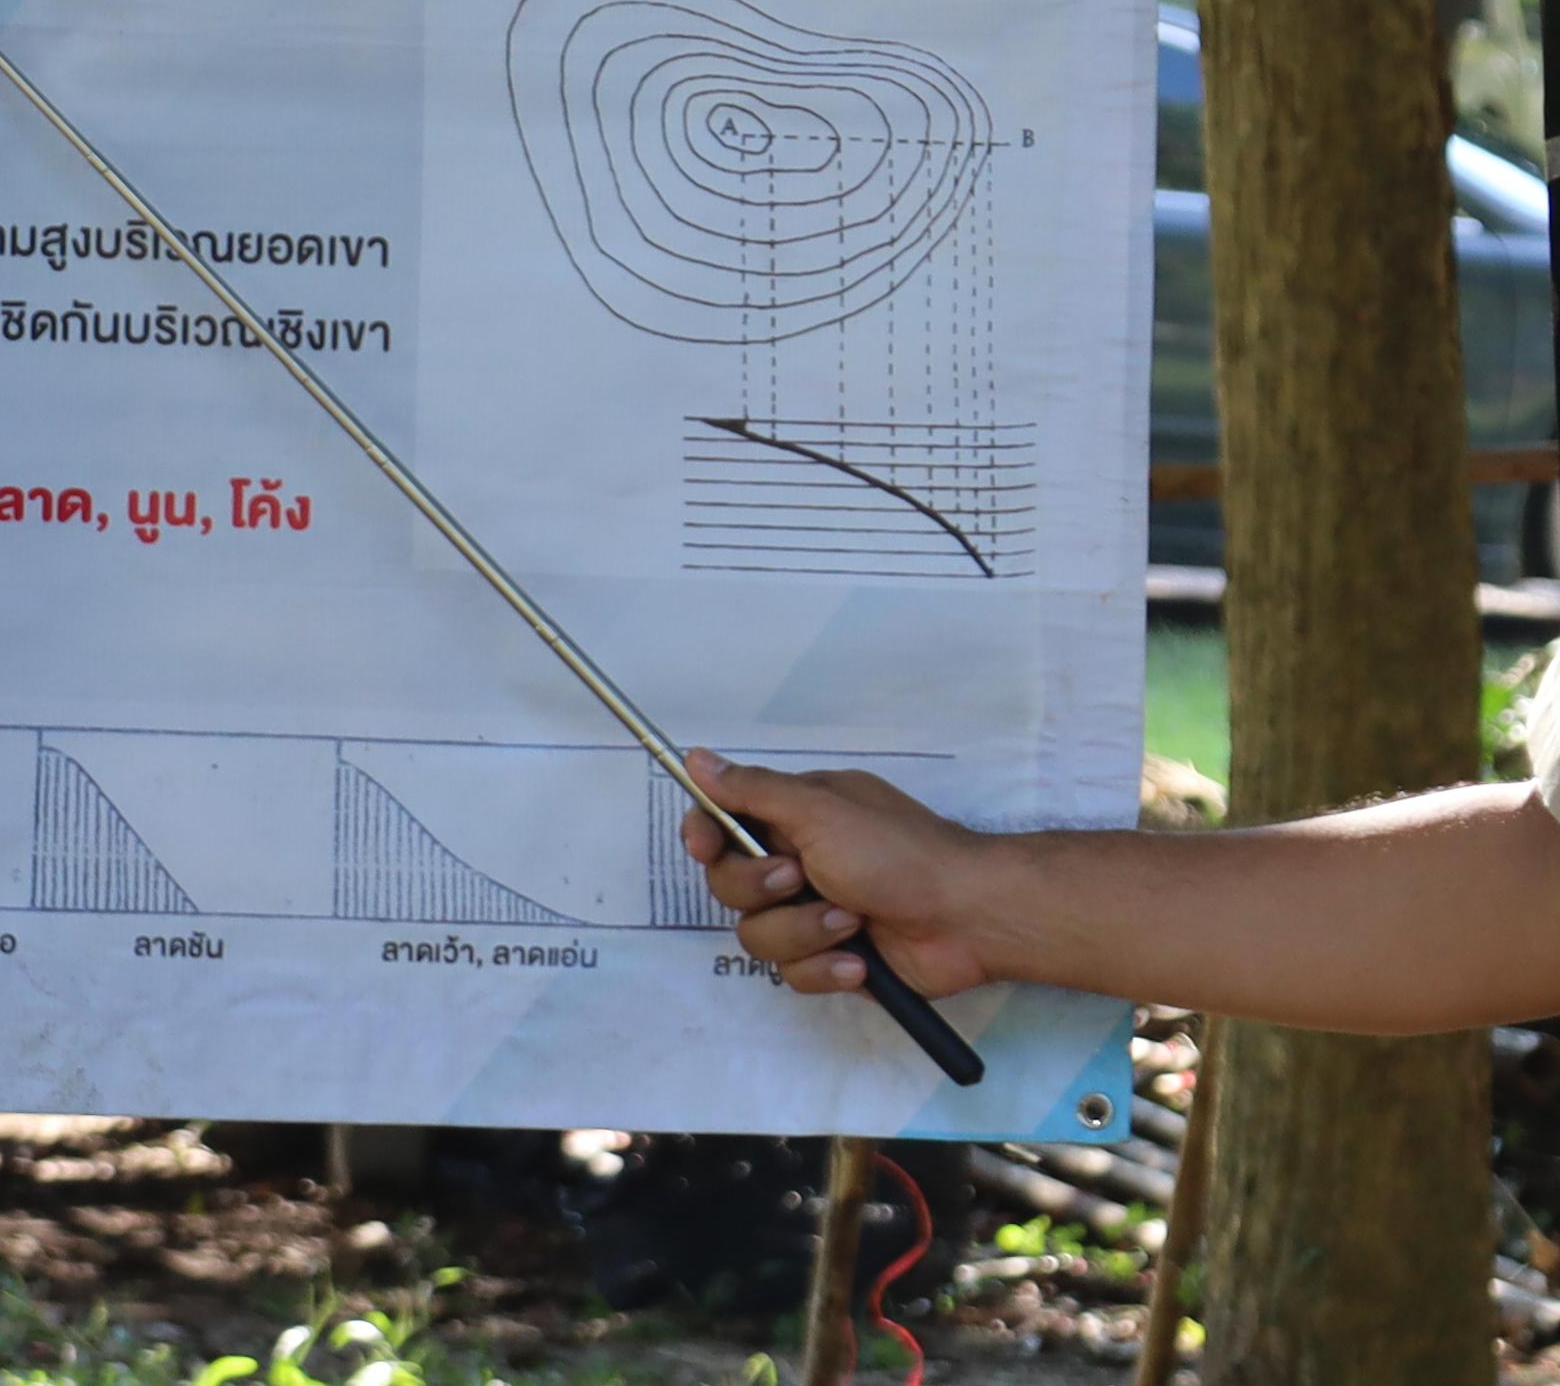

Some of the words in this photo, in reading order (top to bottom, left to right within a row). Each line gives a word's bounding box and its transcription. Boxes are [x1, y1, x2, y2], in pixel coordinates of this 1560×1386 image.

[720, 117, 739, 136] A
[1021, 128, 1035, 148] B
[128, 489, 213, 545] นูน,
[231, 478, 312, 532] โค้ง
[133, 930, 225, 960] ลาดชัน
[381, 935, 483, 969] ลาดเว้า,
[492, 938, 599, 969] ลาดแอ่น
